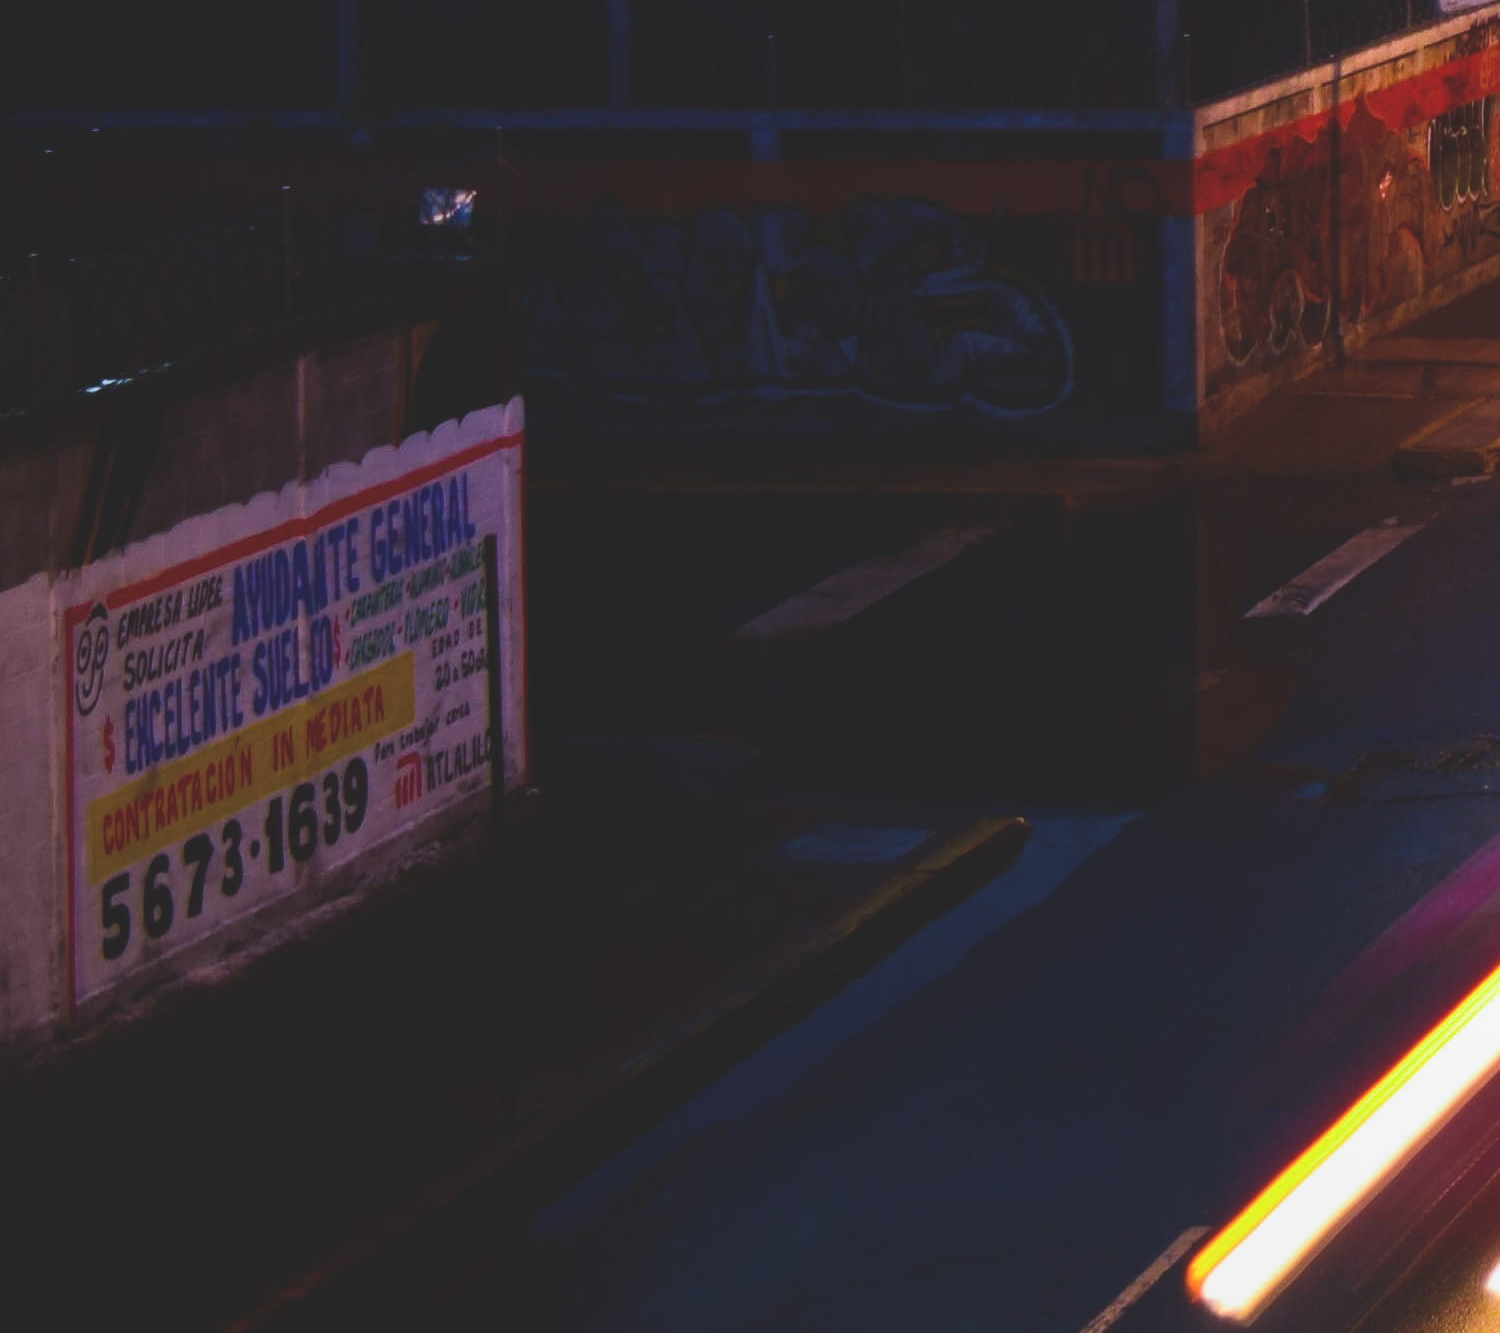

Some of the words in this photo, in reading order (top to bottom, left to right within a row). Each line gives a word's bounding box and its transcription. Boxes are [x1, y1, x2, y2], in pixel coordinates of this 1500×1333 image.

[118, 590, 182, 649] EMPRESA
[188, 574, 223, 618] LIDER
[232, 517, 359, 647] AYUDANTE
[371, 469, 476, 583] GENERAL
[123, 628, 205, 692] SOLICITA
[124, 652, 244, 775] EXCELENTE
[101, 736, 252, 855] CONTRATACIÓN
